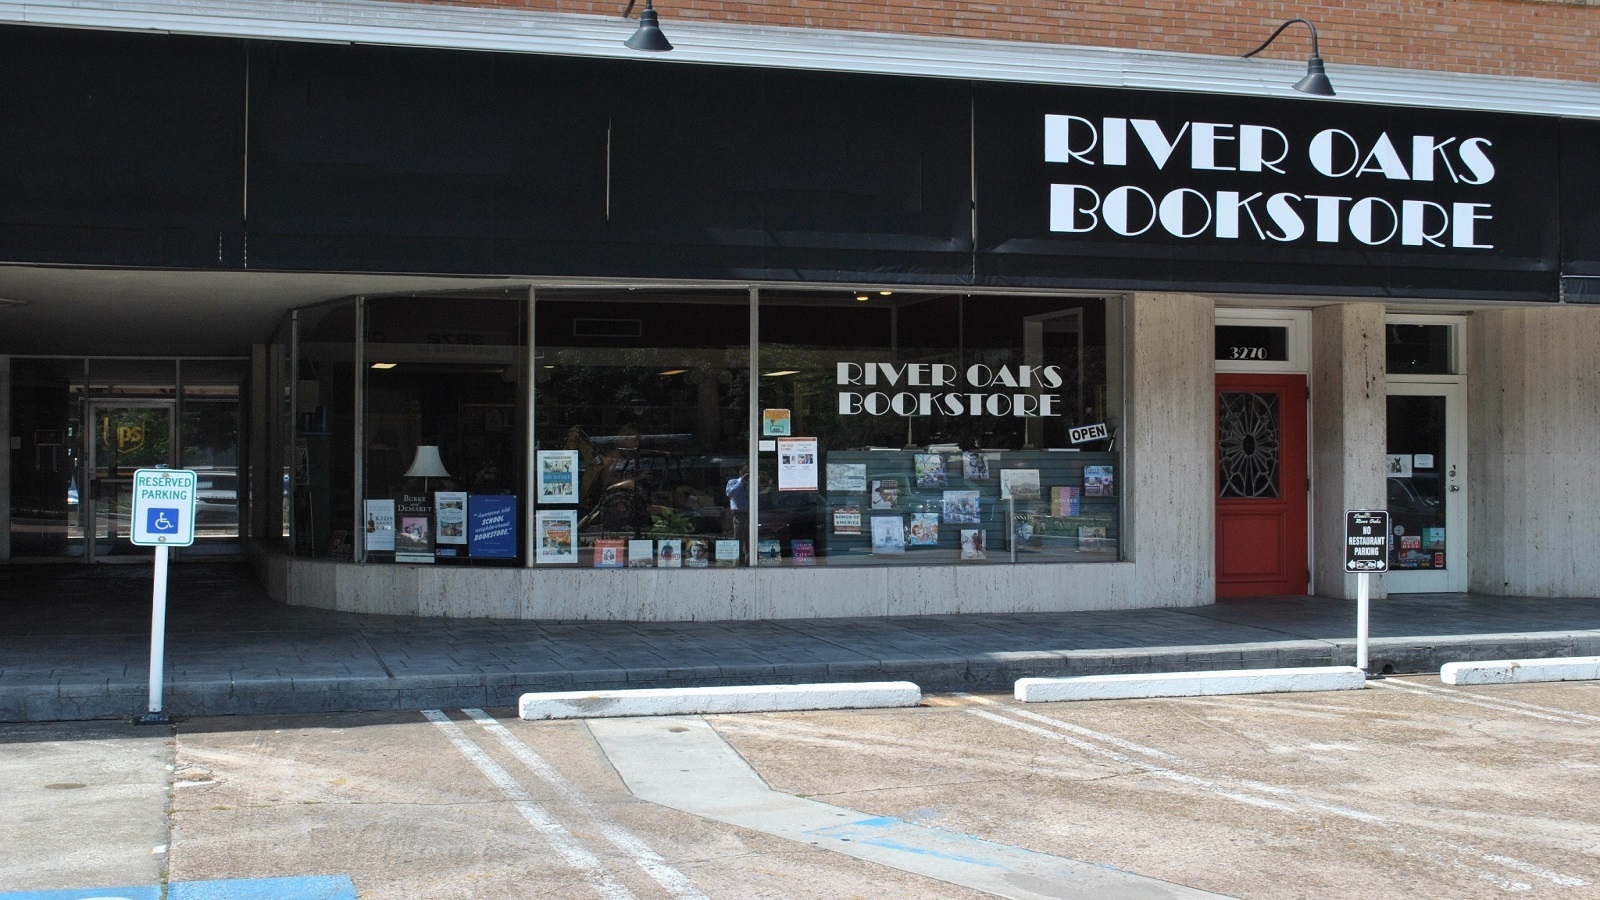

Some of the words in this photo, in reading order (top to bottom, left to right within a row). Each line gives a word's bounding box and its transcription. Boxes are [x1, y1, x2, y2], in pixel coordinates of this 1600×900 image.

[1044, 113, 1289, 175] RIVER
[1308, 128, 1496, 185] OAKS
[1049, 183, 1495, 249] BOOKSTORE
[1229, 346, 1268, 360] 3270
[836, 362, 957, 387] RIVER
[966, 363, 1063, 389] OAKS
[838, 392, 1062, 417] BOOKSTORE
[1071, 425, 1106, 441] OPEN
[138, 477, 192, 488] RESERVED
[141, 489, 188, 501] PARKING
[481, 515, 504, 526] SCHOOL
[1362, 526, 1371, 535] NO
[1348, 536, 1385, 545] RESTAURANT
[1354, 547, 1379, 556] PARKING
